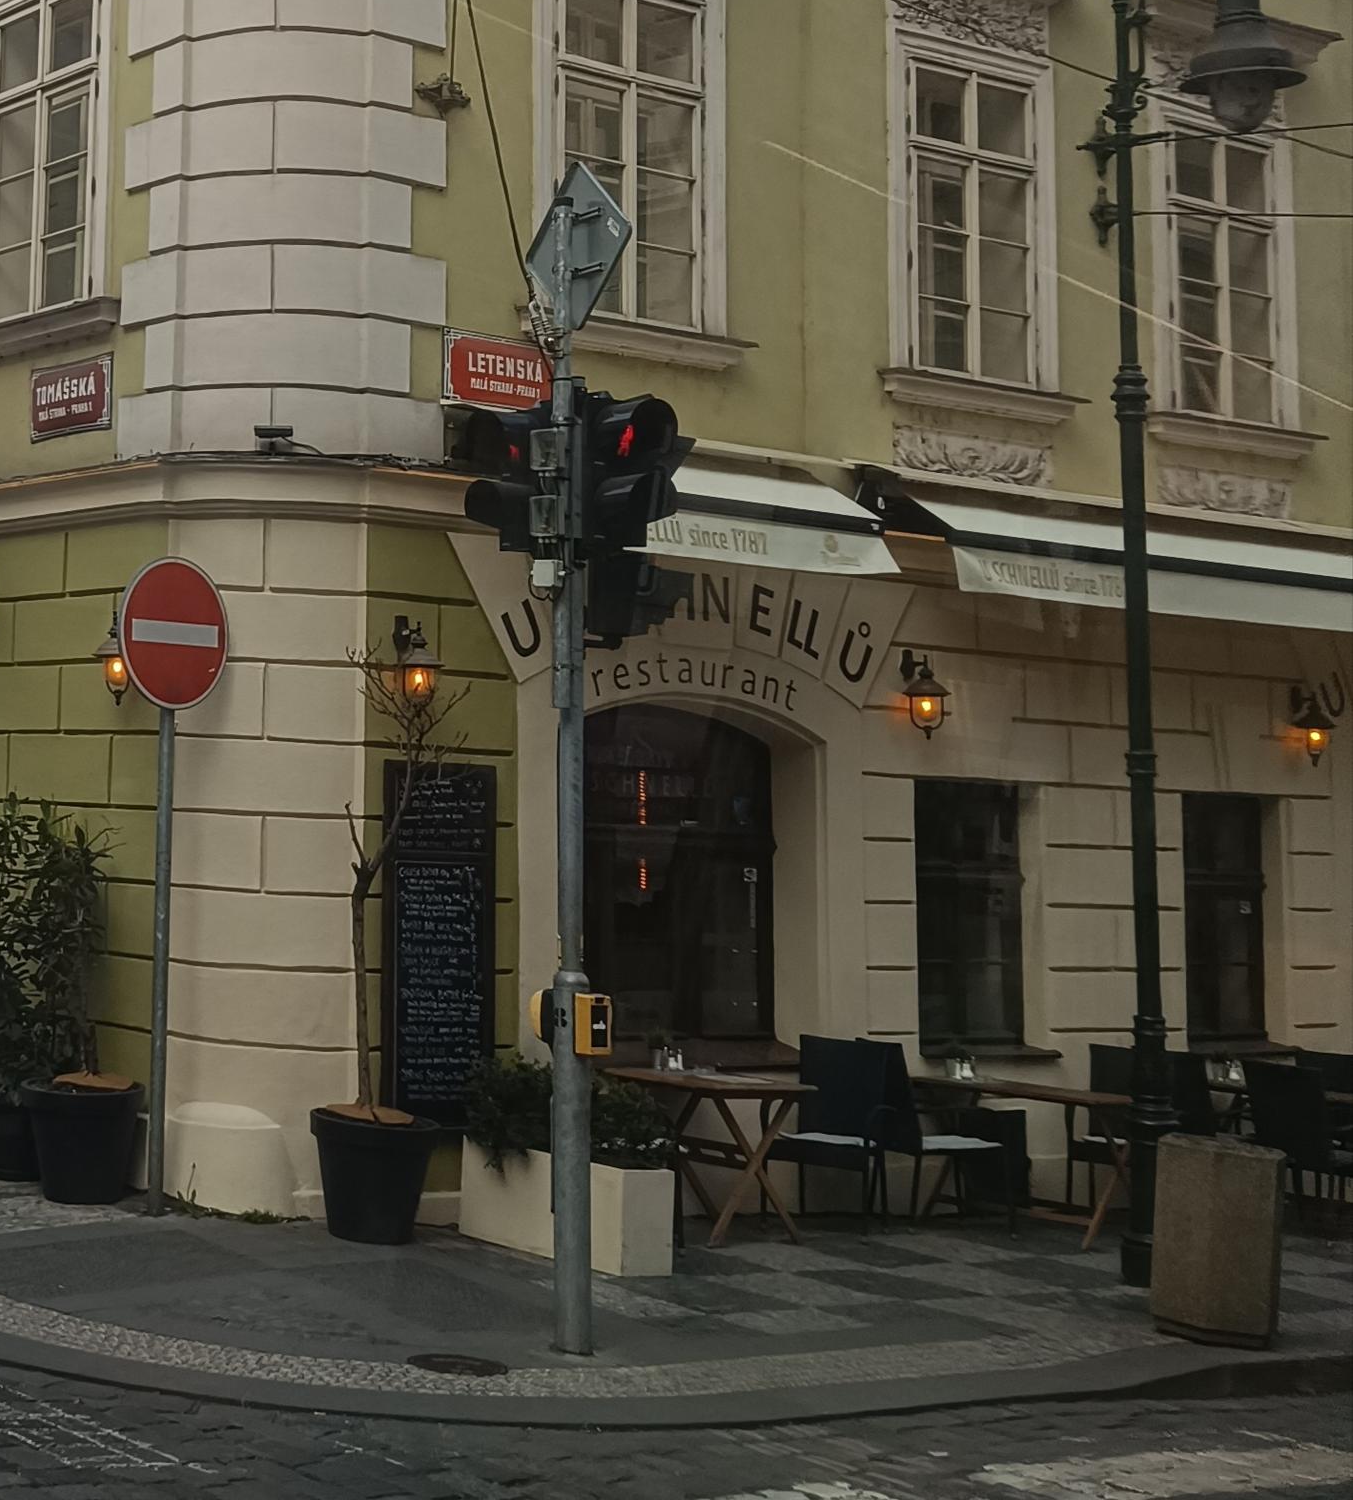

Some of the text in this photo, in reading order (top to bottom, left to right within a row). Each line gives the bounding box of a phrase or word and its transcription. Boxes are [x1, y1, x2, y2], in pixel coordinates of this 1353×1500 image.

[468, 351, 543, 383] LETENSKÁ
[36, 371, 96, 406] TOMÁŠSKÁ
[470, 377, 488, 391] MALÁ
[688, 523, 729, 550] since
[731, 528, 768, 555] 1787
[500, 598, 541, 658] U
[590, 652, 798, 712] restaurant
